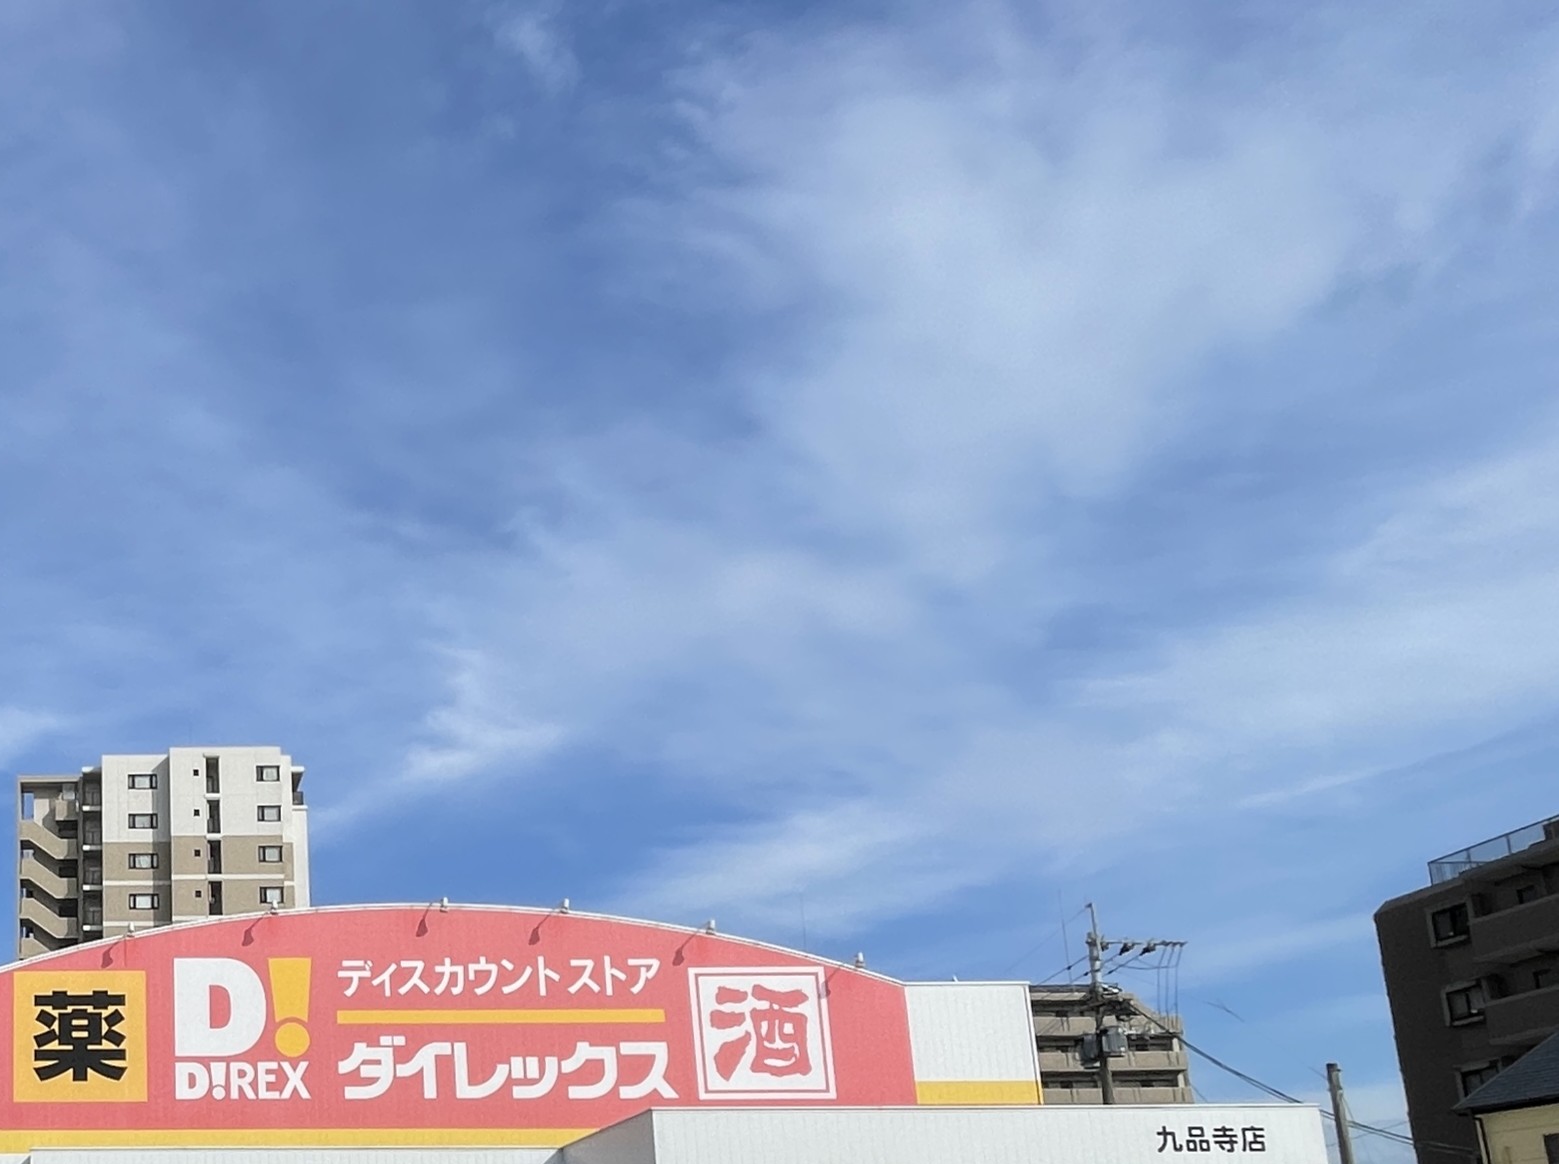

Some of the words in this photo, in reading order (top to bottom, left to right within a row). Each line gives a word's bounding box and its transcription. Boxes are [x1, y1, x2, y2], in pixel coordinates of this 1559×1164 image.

[33, 990, 128, 1081] 薬
[338, 1035, 679, 1100] ダイレックス
[710, 984, 812, 1081] 酒
[1156, 1125, 1266, 1153] 九品寺店
